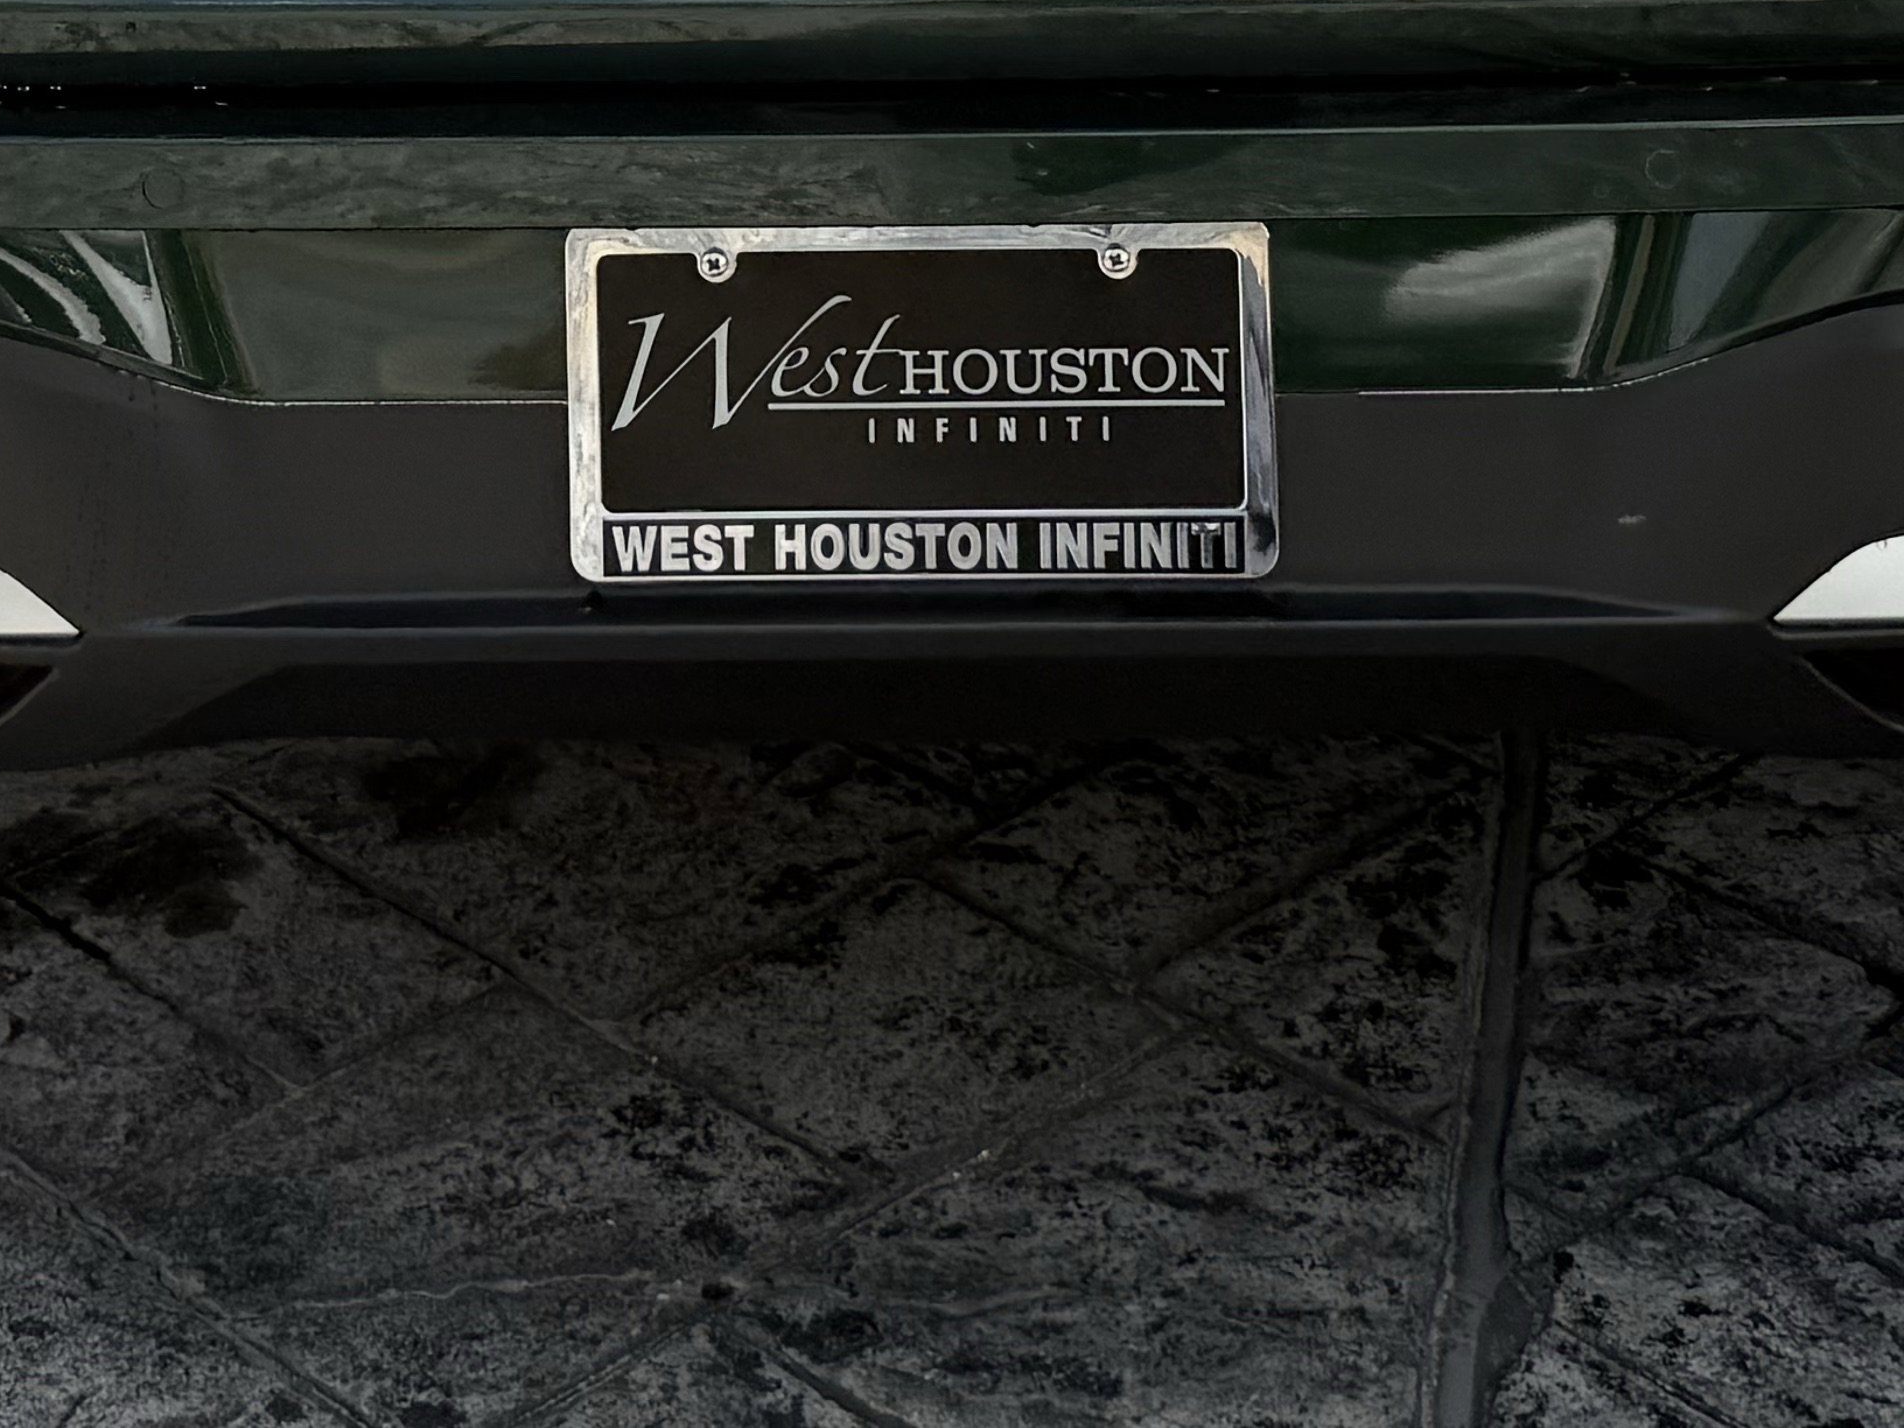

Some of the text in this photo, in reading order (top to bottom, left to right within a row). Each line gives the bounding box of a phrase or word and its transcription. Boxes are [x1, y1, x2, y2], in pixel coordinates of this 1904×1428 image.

[611, 295, 1228, 432] West HOUSTON
[867, 416, 1112, 444] INFINITI
[612, 521, 1237, 574] WEST HOUSTON INFINITI
